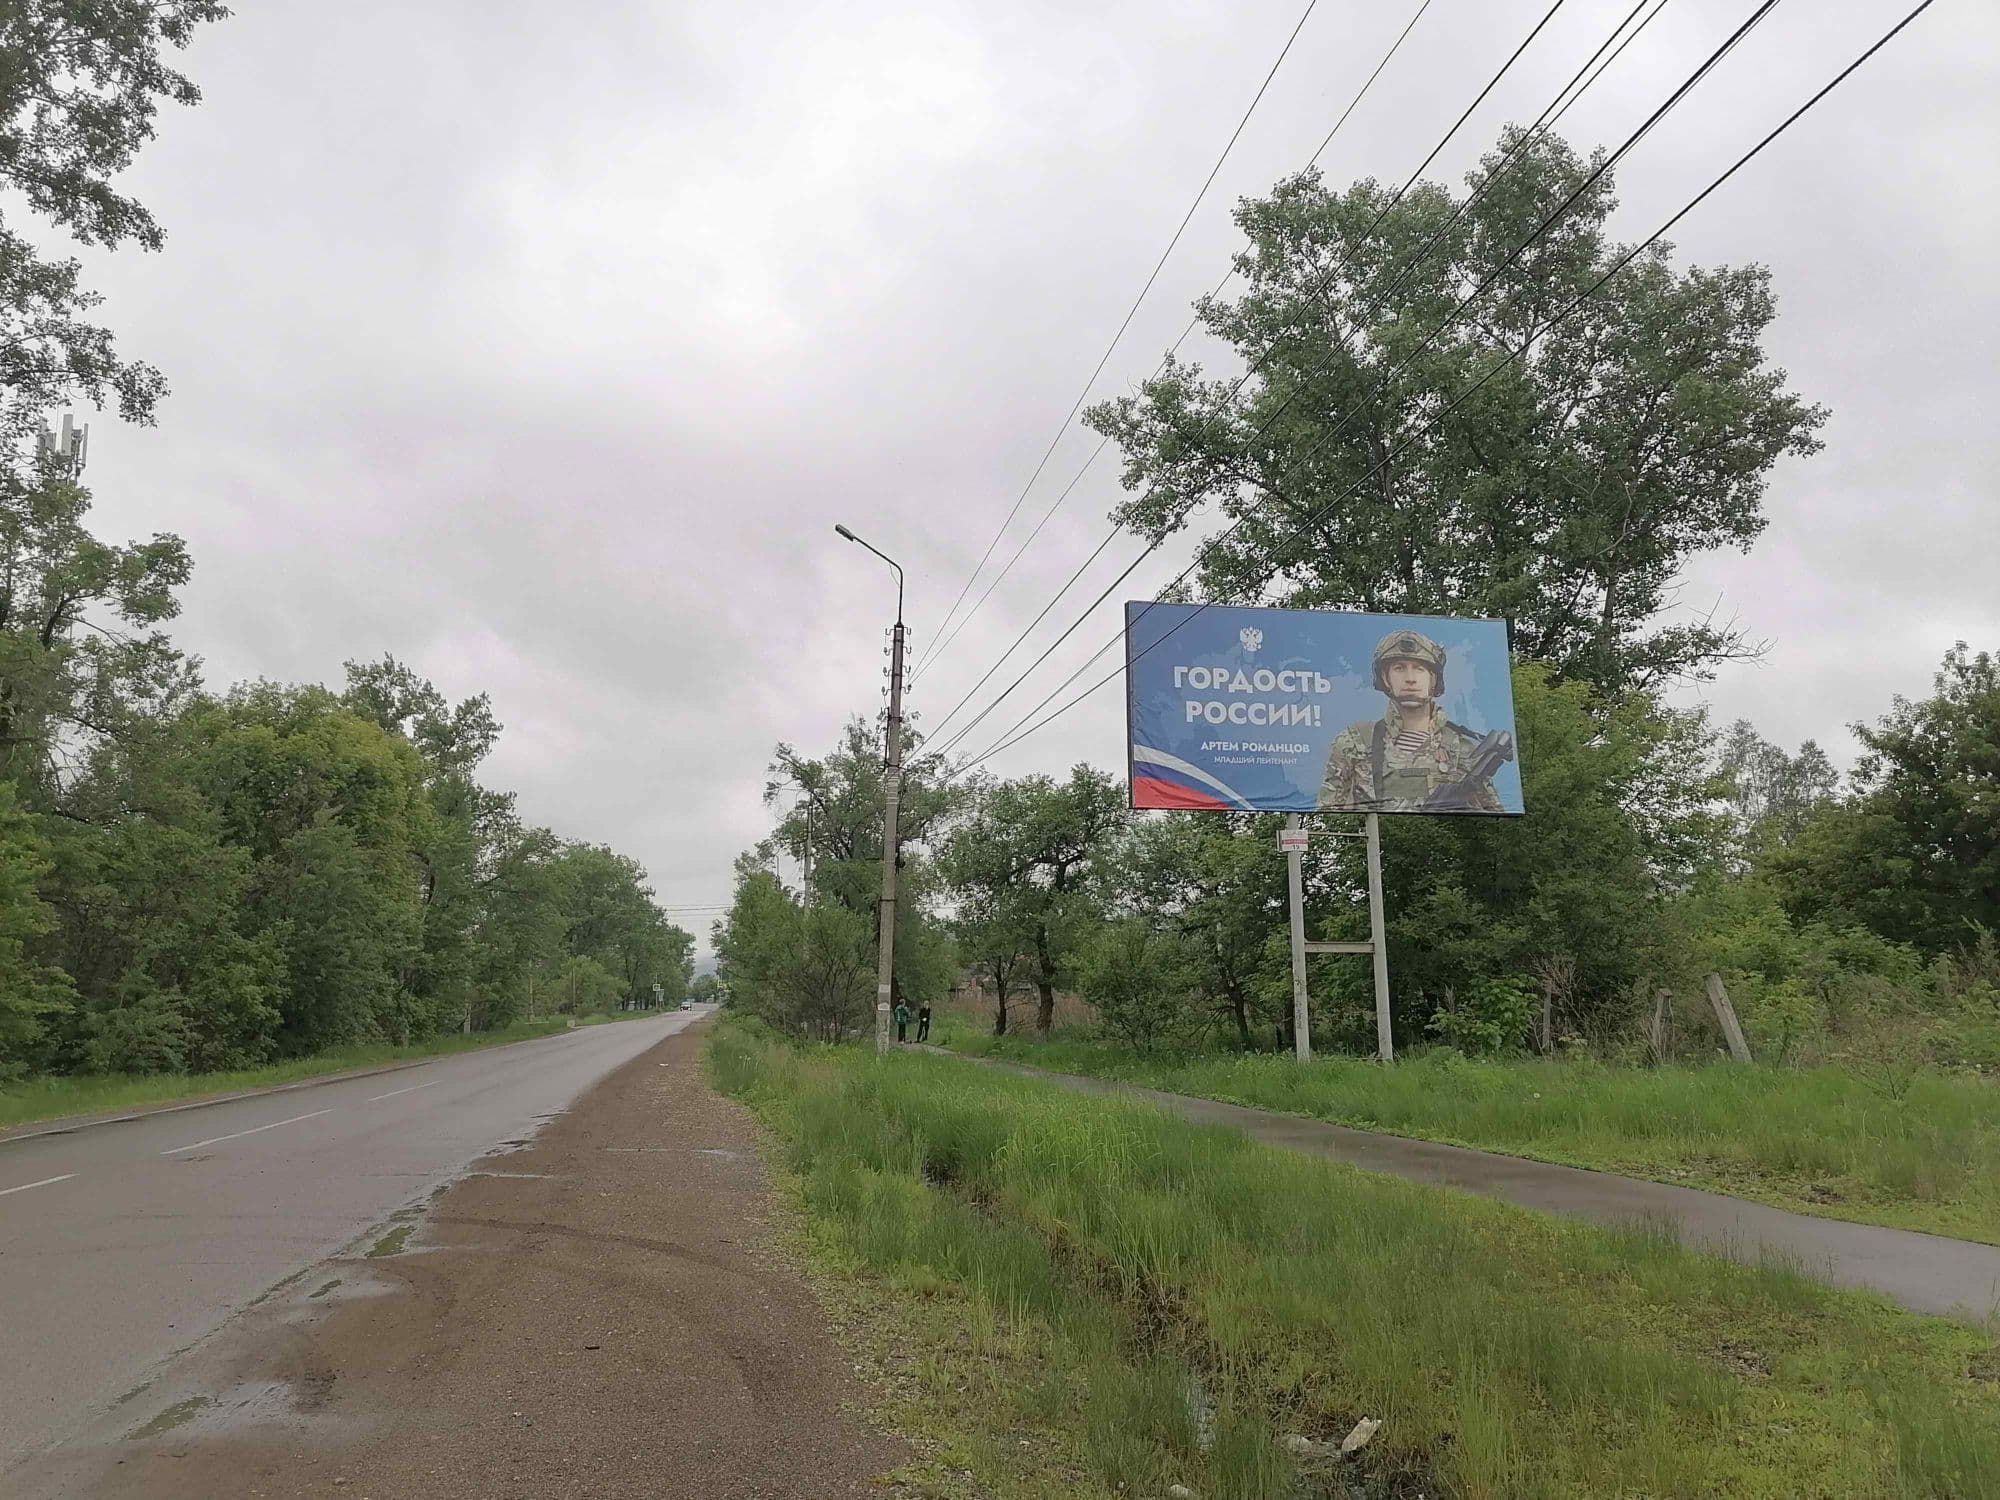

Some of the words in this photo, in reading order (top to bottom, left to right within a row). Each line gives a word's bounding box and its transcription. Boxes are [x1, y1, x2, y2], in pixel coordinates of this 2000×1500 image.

[1173, 665, 1331, 693] ГОРДОСТЬ
[1185, 700, 1322, 728] РОССИИ!
[1200, 741, 1239, 752] АРТЕМ
[1242, 742, 1310, 754] РОМАНЦОВ
